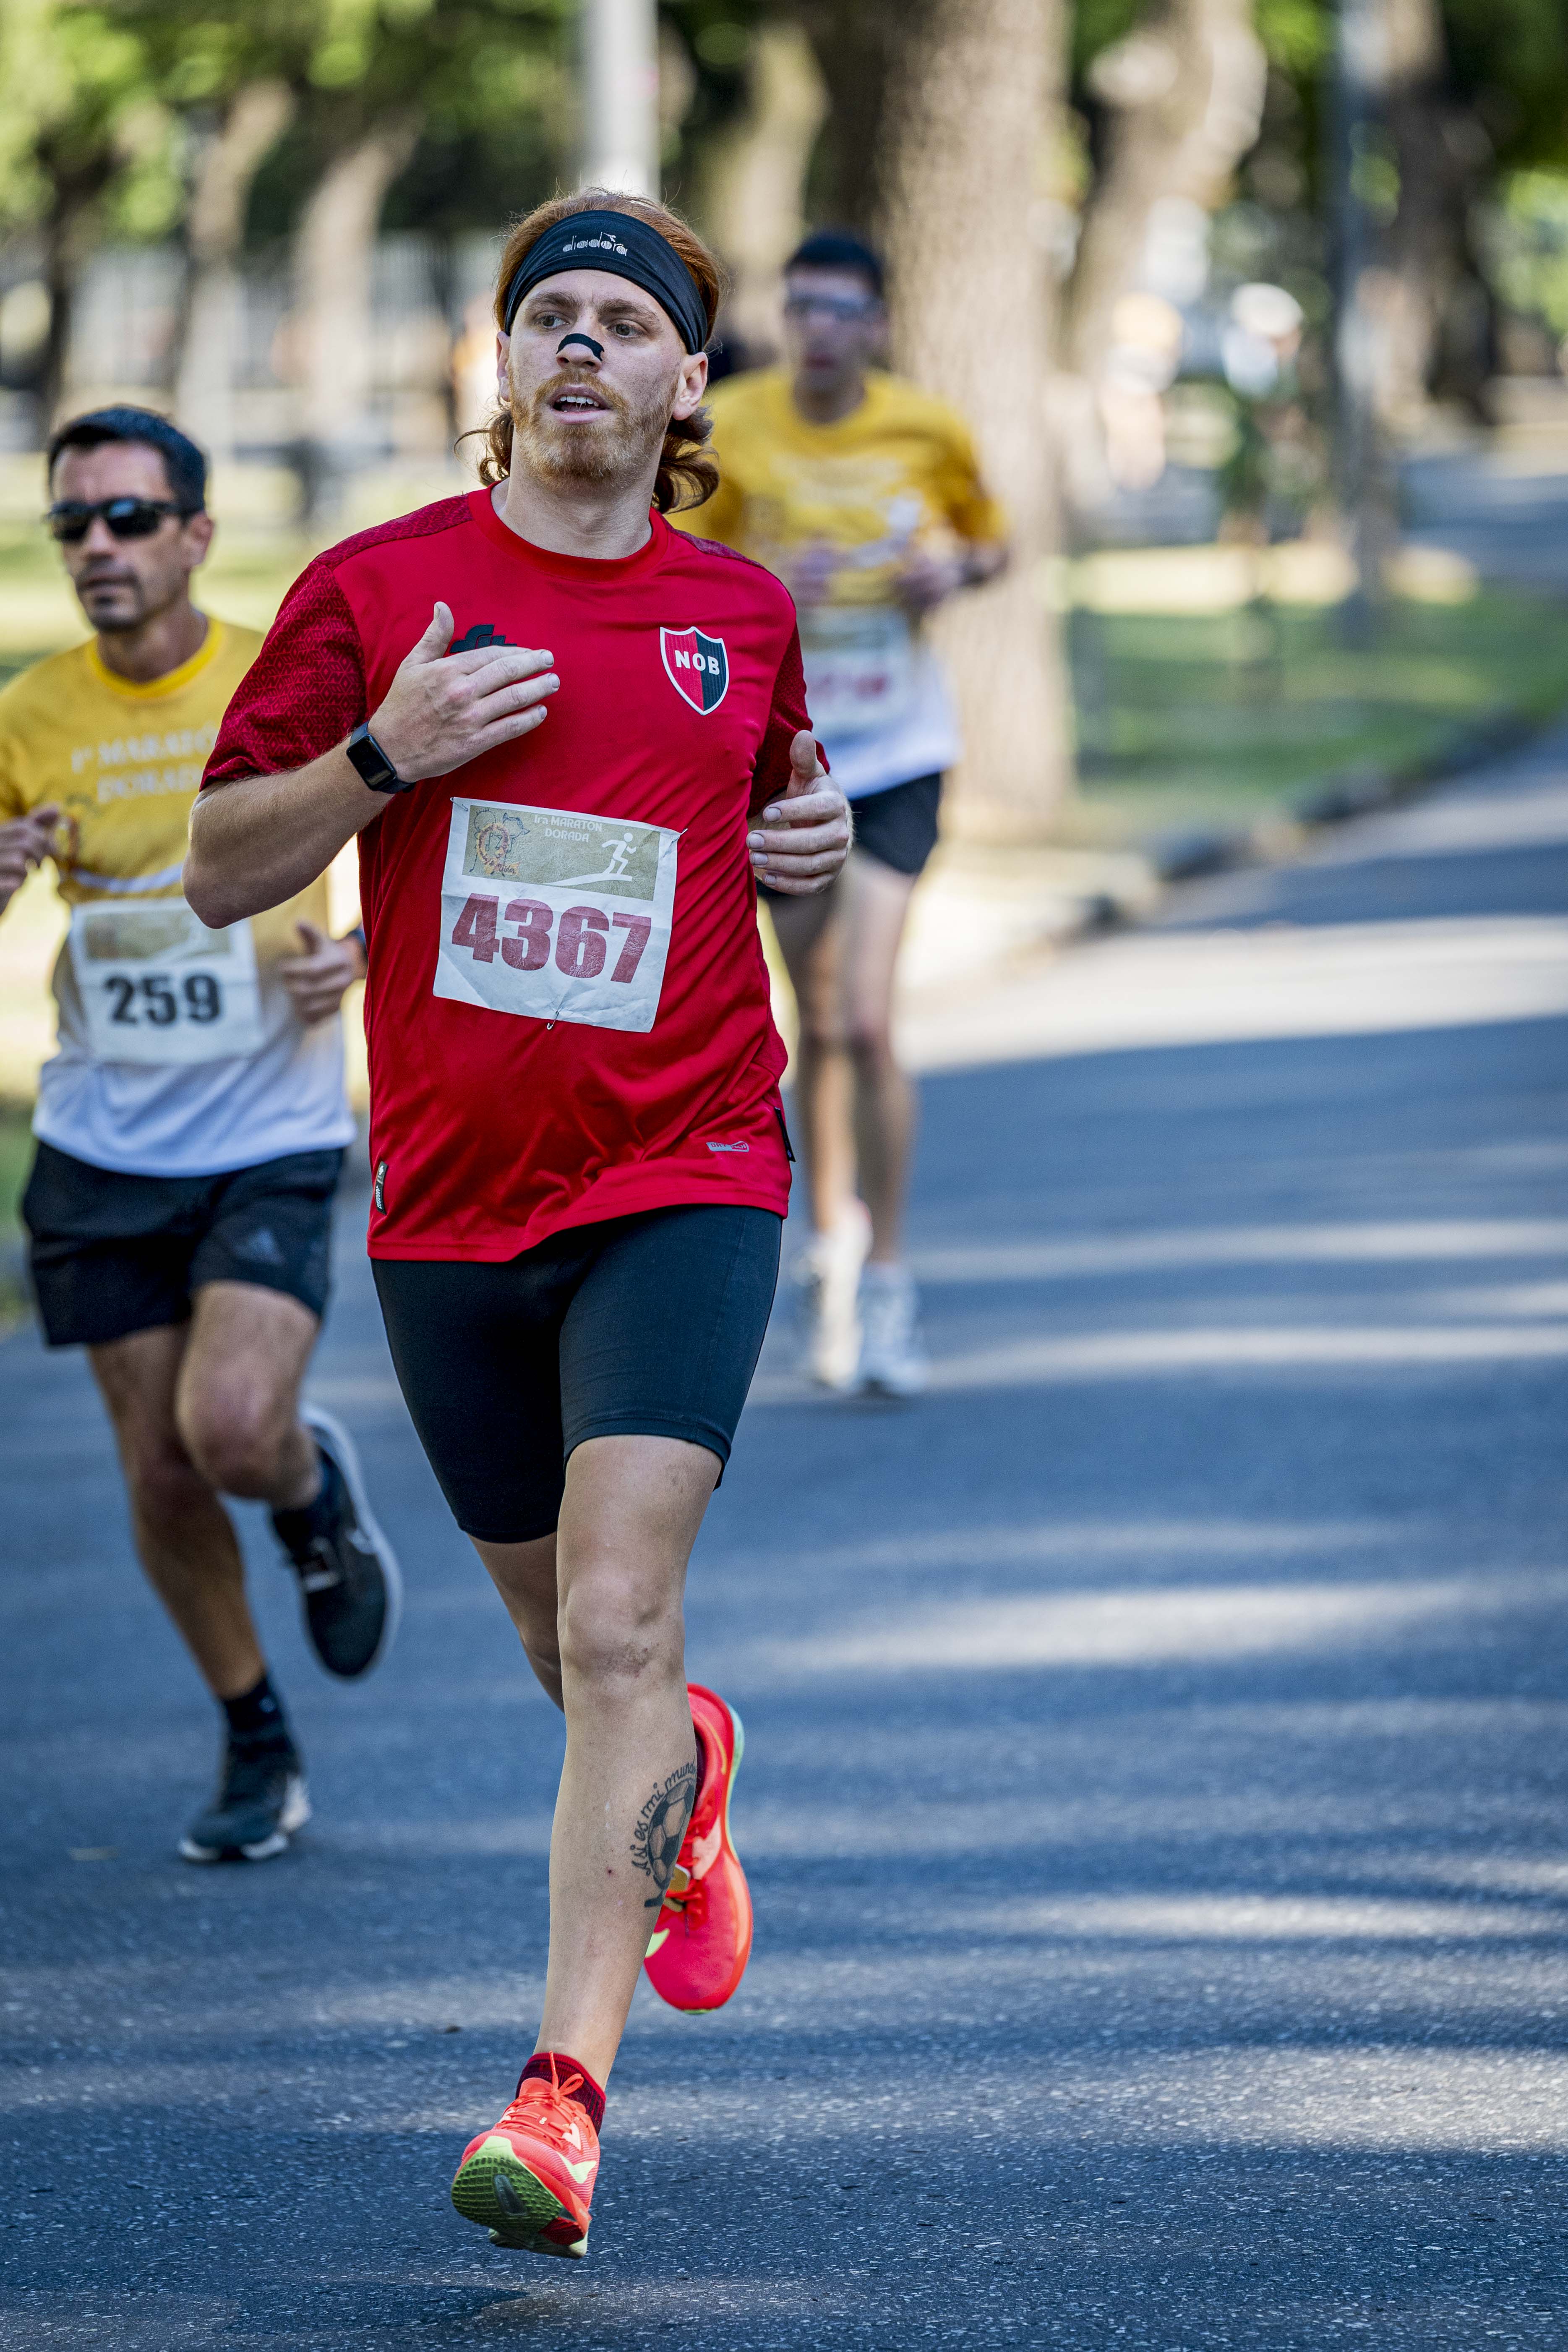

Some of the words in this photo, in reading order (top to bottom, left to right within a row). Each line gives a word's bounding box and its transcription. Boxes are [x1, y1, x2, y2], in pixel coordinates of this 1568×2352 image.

[562, 231, 628, 256] diadora
[675, 650, 720, 675] NOB
[545, 828, 590, 842] DORADA
[550, 816, 603, 832] MARATON
[451, 893, 652, 984] 4367
[104, 972, 222, 1026] 259
[641, 1782, 664, 1819] mi
[634, 1820, 649, 1842] es
